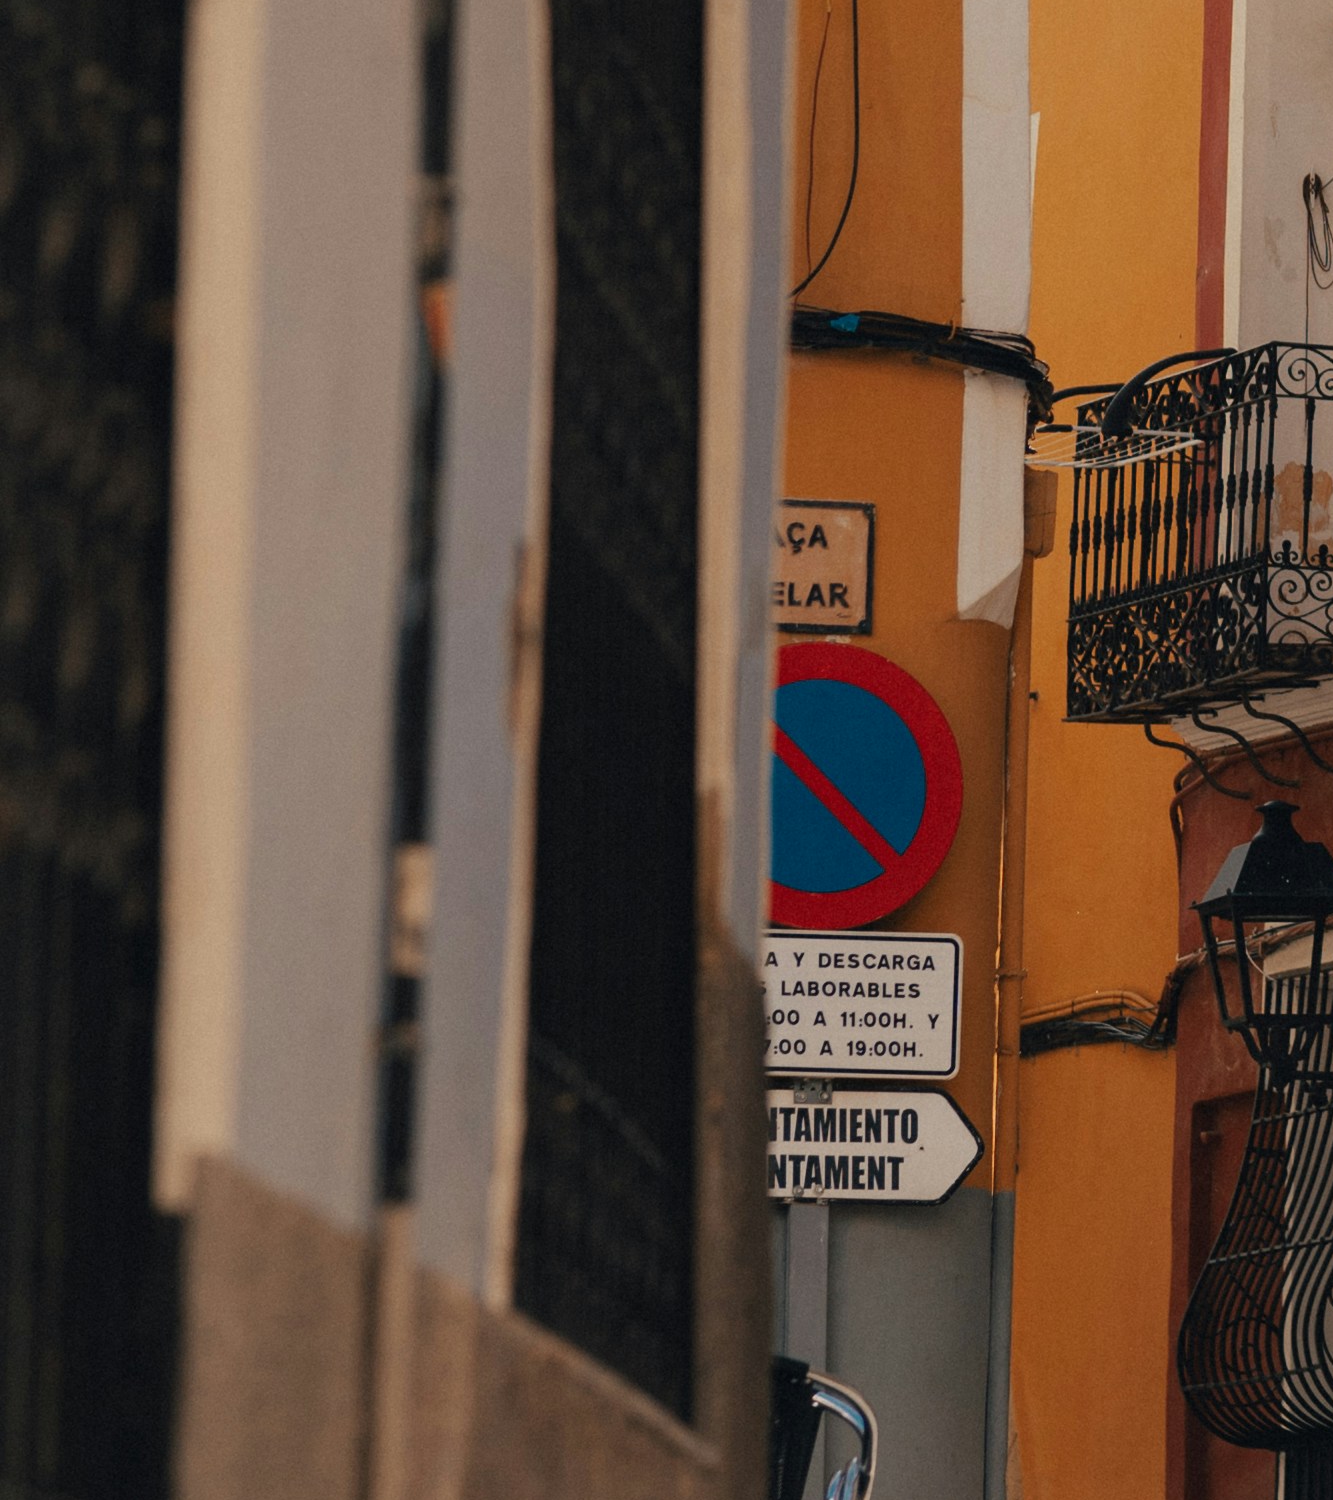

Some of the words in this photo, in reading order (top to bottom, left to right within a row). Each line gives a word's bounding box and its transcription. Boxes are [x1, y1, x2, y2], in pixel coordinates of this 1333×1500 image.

[793, 952, 805, 968] Y
[818, 952, 936, 971] DESCARGA
[780, 981, 921, 999] LABORABLES
[813, 1010, 827, 1027] A
[840, 1011, 914, 1029] 11:00H.
[927, 1013, 940, 1030] Y
[819, 1040, 834, 1056] A
[846, 1041, 924, 1058] 19:00H.
[768, 1154, 904, 1191] NTAMENT
